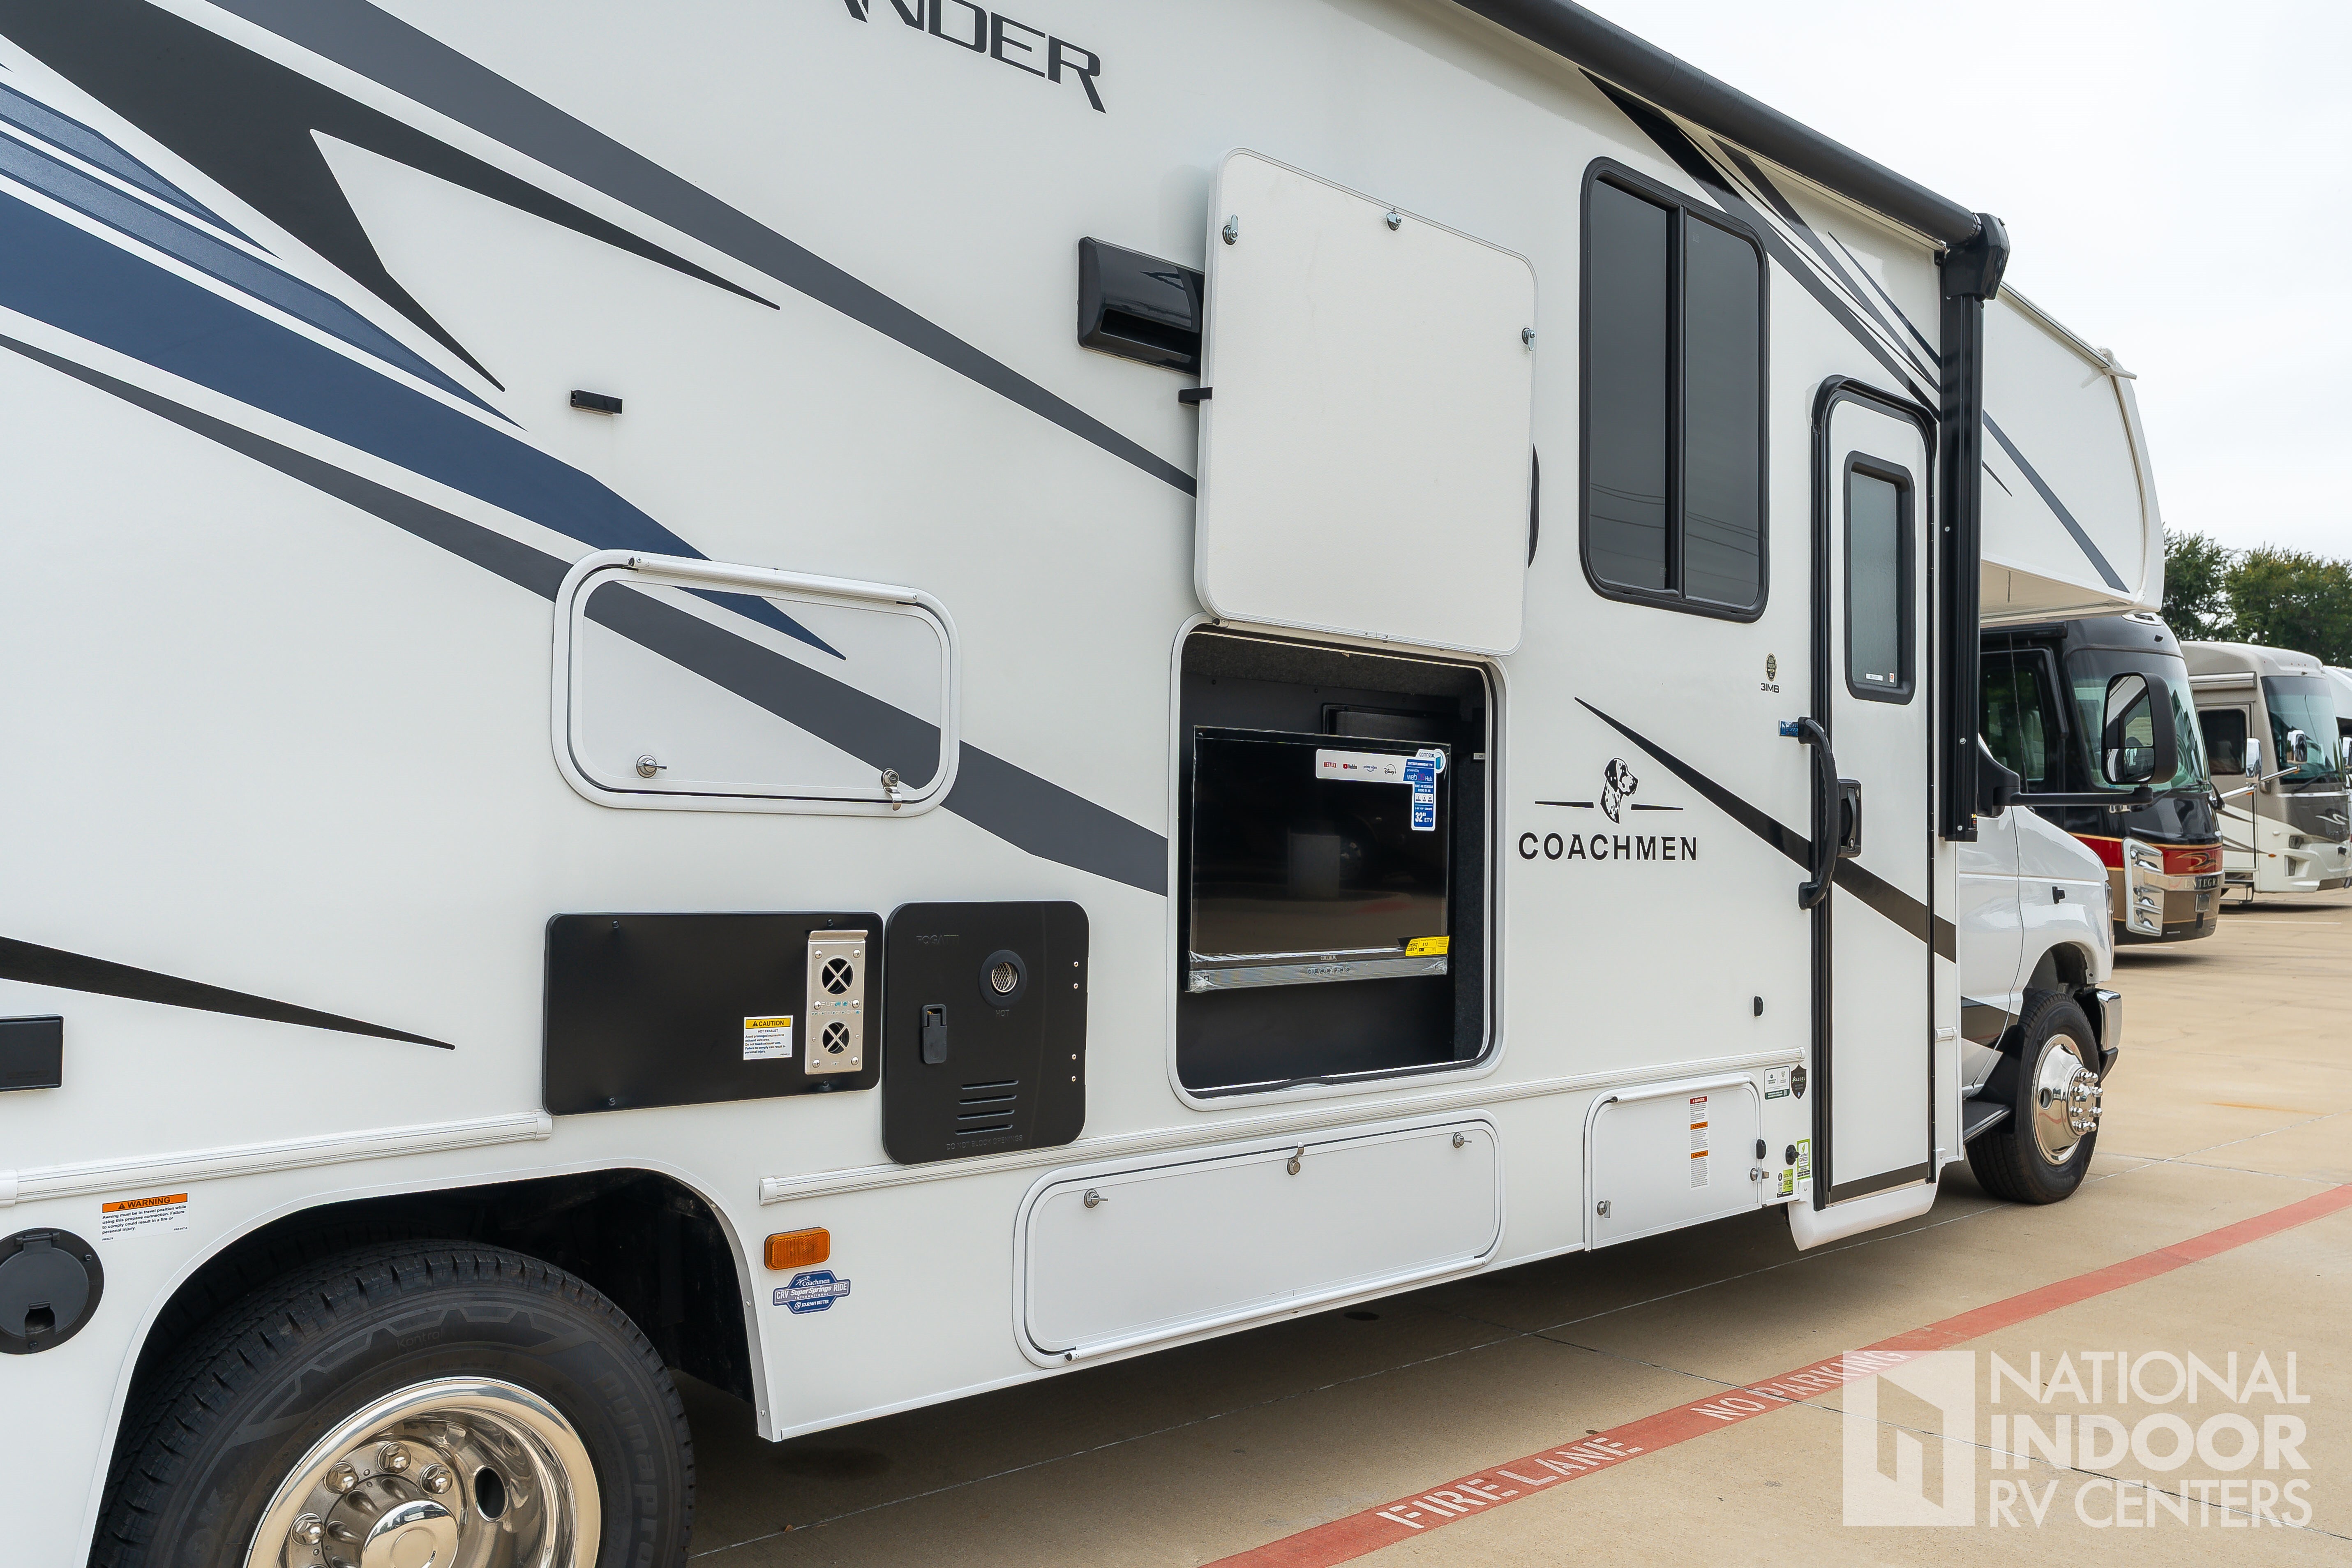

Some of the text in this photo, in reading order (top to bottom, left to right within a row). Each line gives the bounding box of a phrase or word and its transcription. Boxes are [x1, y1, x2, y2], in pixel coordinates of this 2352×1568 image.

[843, 0, 1106, 114] NDER
[1518, 831, 1697, 861] COACHMEN
[971, 1139, 992, 1147] BLOCK
[993, 1135, 1023, 1145] OPENINGS
[128, 1196, 171, 1208] WARNING
[776, 1283, 847, 1300] CRV SuperSprings RIDE
[397, 1328, 444, 1350] Kontrol
[1376, 1351, 1911, 1529] FIRE LANE NO PARKING
